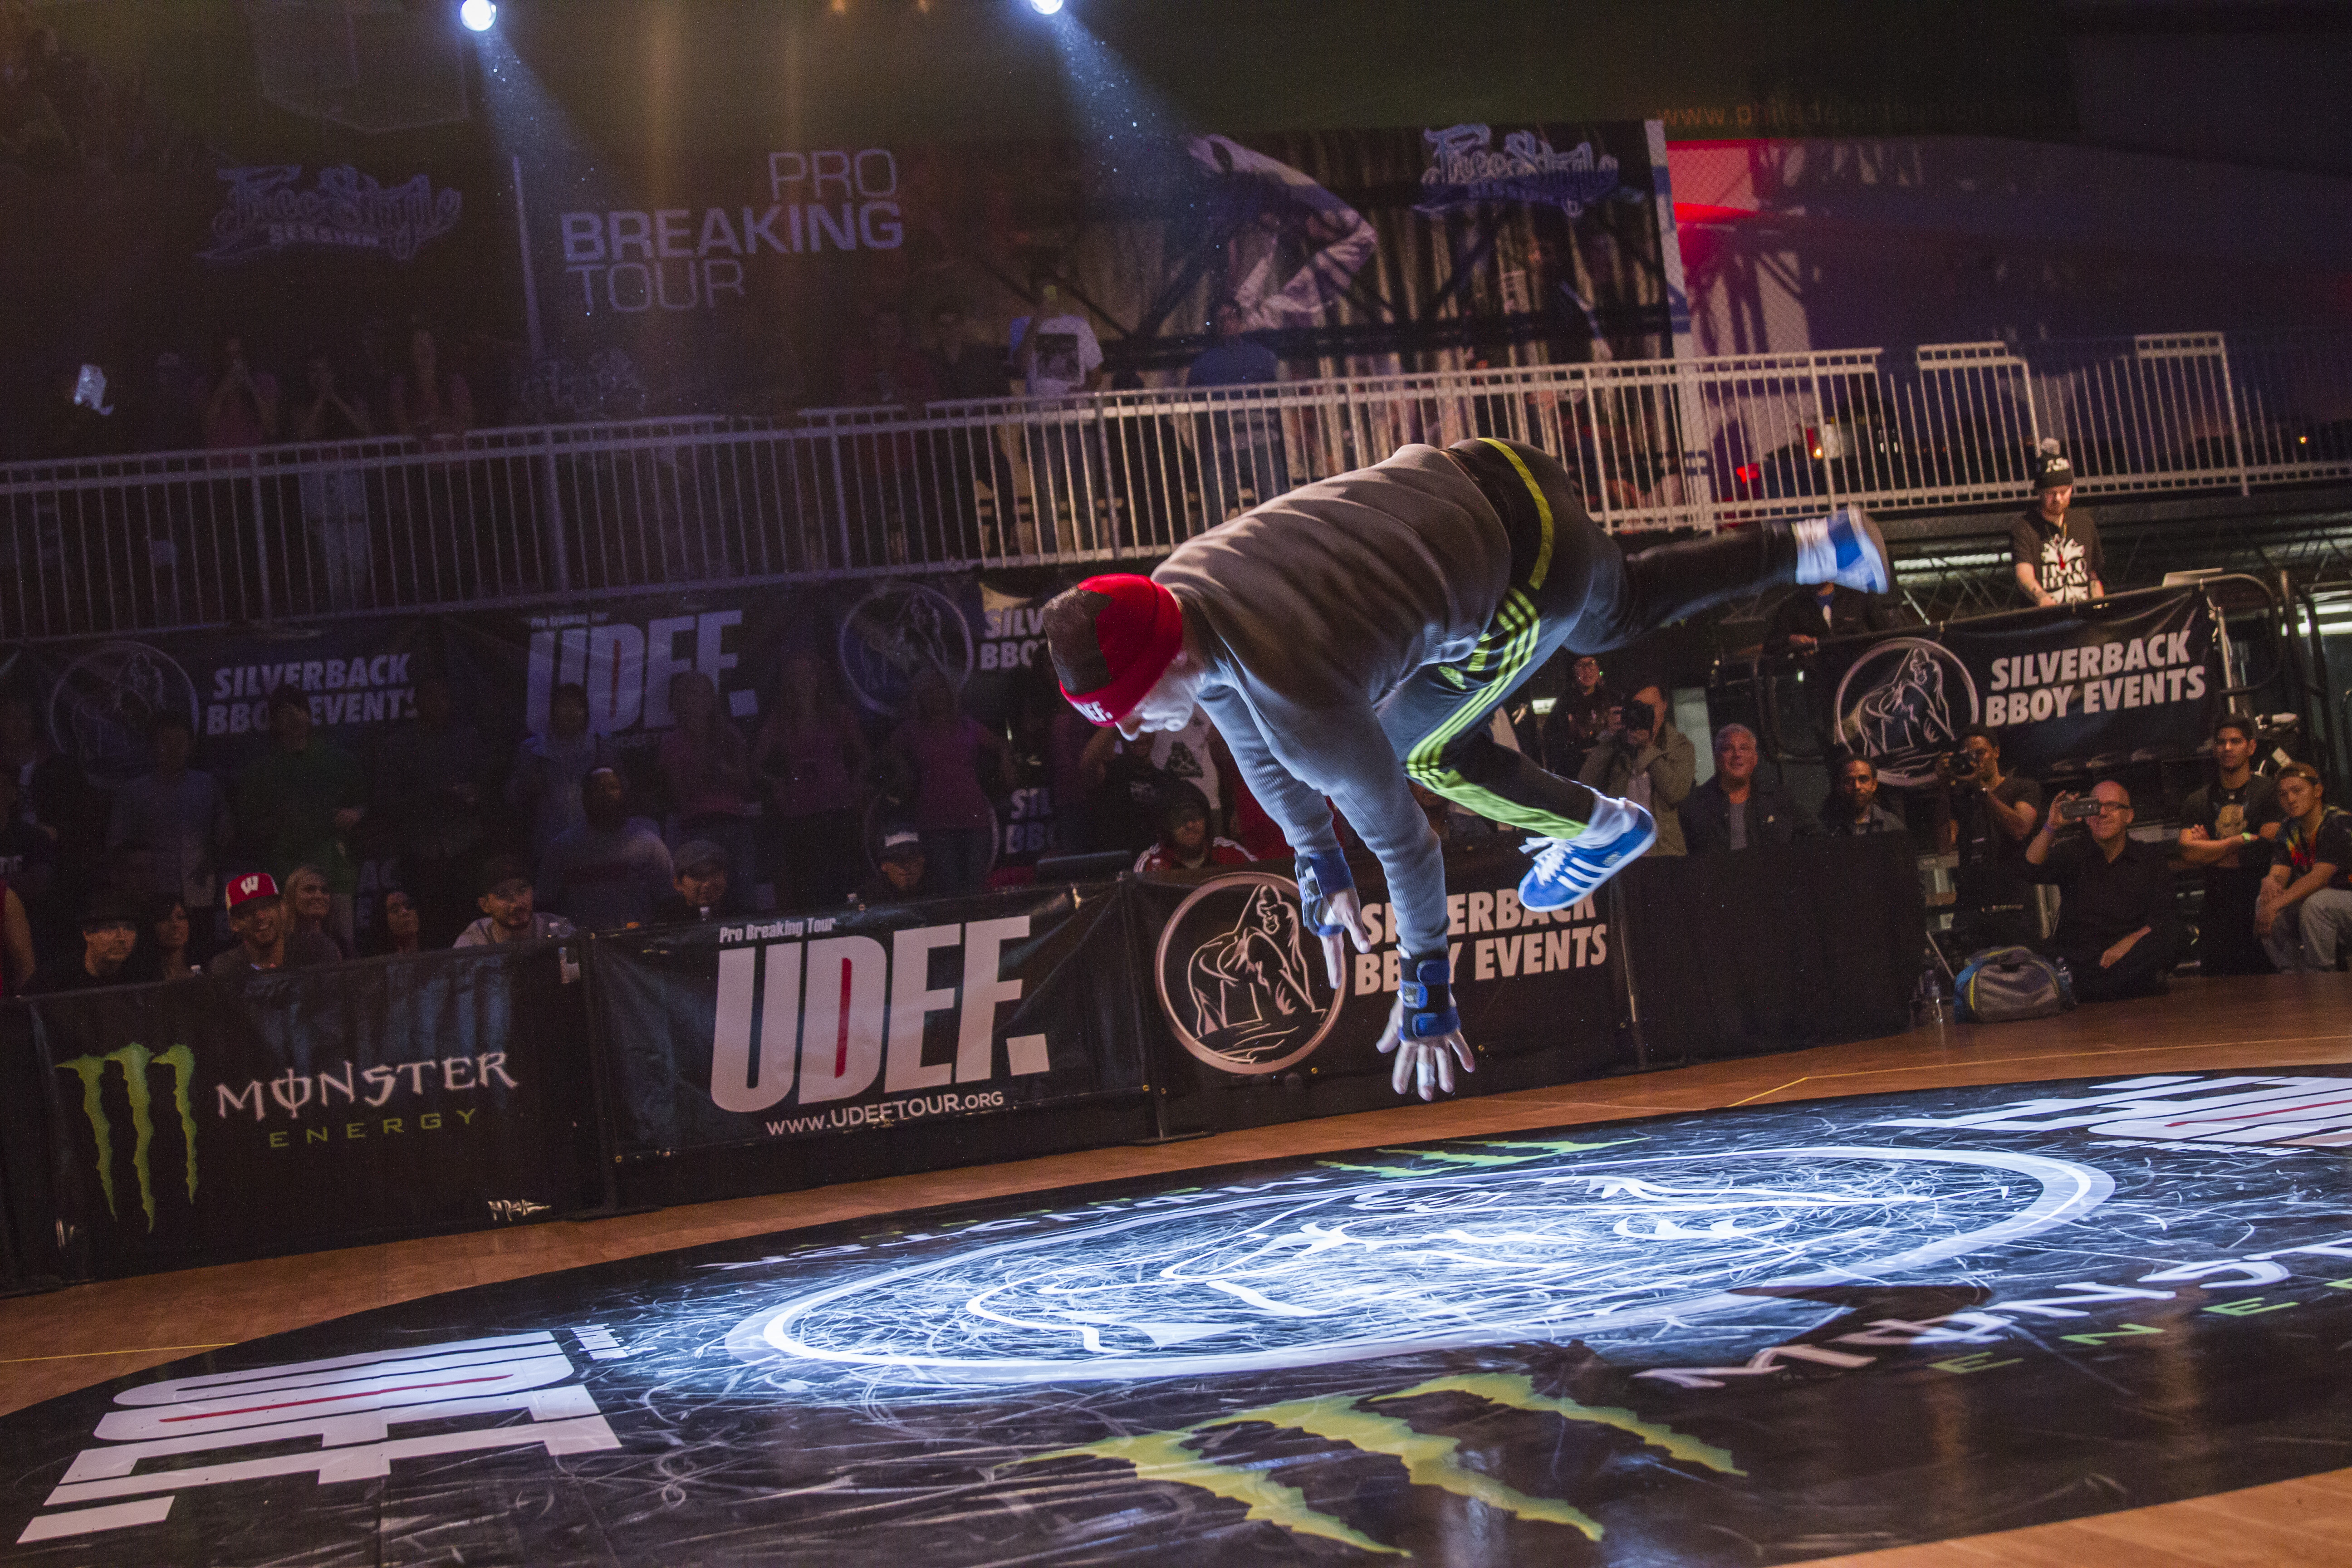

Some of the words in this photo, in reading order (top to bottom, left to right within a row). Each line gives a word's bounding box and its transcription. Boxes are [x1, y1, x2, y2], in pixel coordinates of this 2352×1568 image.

[768, 148, 897, 201] PRO
[560, 201, 903, 263] BREAKING
[566, 260, 745, 314] TOUR
[212, 653, 410, 701] SILVERBACK
[1990, 630, 2191, 692] SILVERBACK
[1986, 684, 2073, 727] BBOY
[2083, 665, 2206, 714] EVENTS
[240, 875, 259, 896] W
[719, 927, 743, 943] Pro
[746, 920, 804, 941] Breaking
[807, 917, 836, 933] Tour
[1475, 924, 1607, 981] EVENTS
[710, 915, 1050, 1113] UDEF.
[216, 1051, 519, 1121] MONSTER
[766, 1091, 1004, 1135] WWW.UDEFTOUR.ORG
[270, 1108, 475, 1147] ENERGY
